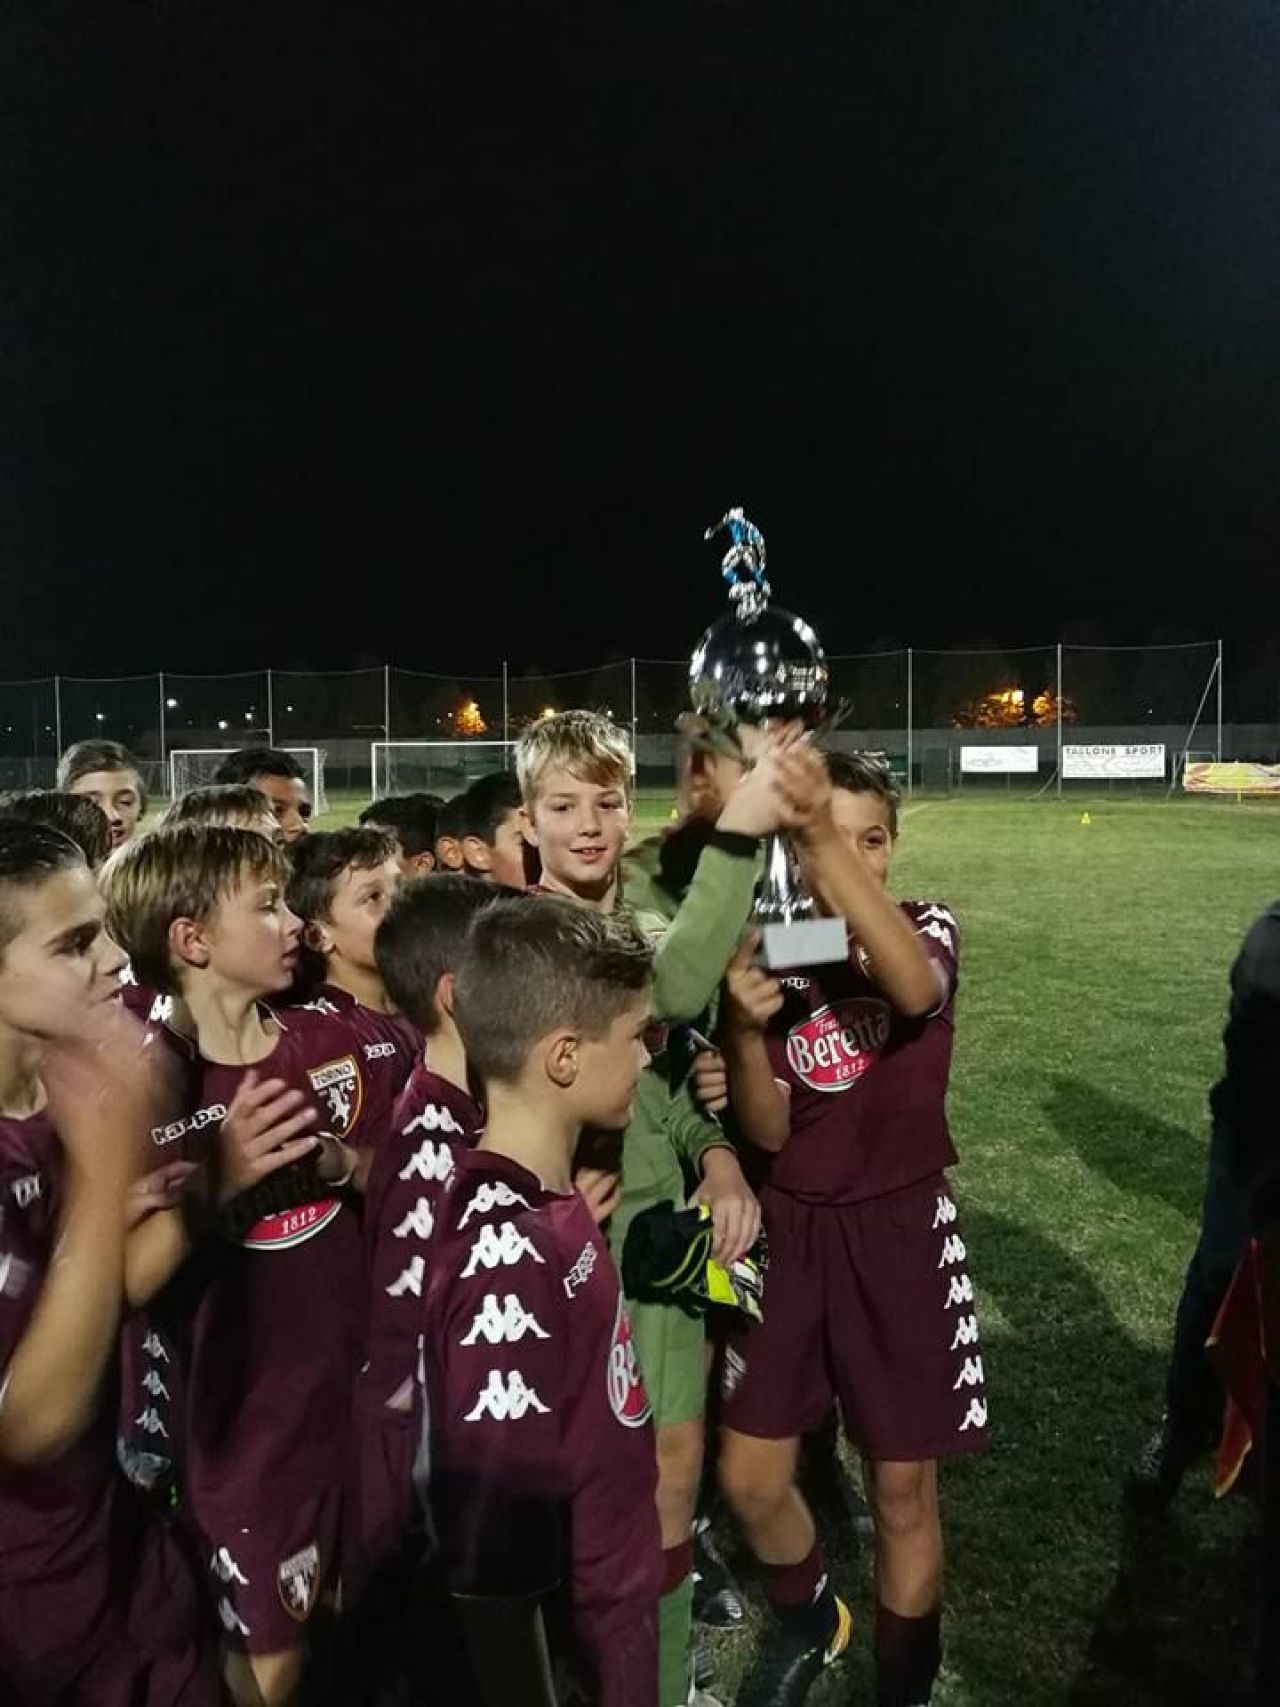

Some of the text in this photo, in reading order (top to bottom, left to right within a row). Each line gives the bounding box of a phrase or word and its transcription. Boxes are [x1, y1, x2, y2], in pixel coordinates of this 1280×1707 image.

[1125, 744, 1163, 756] SPORT
[787, 1012, 891, 1074] Beretta
[835, 1058, 865, 1080] 1812
[282, 1206, 318, 1235] 1812
